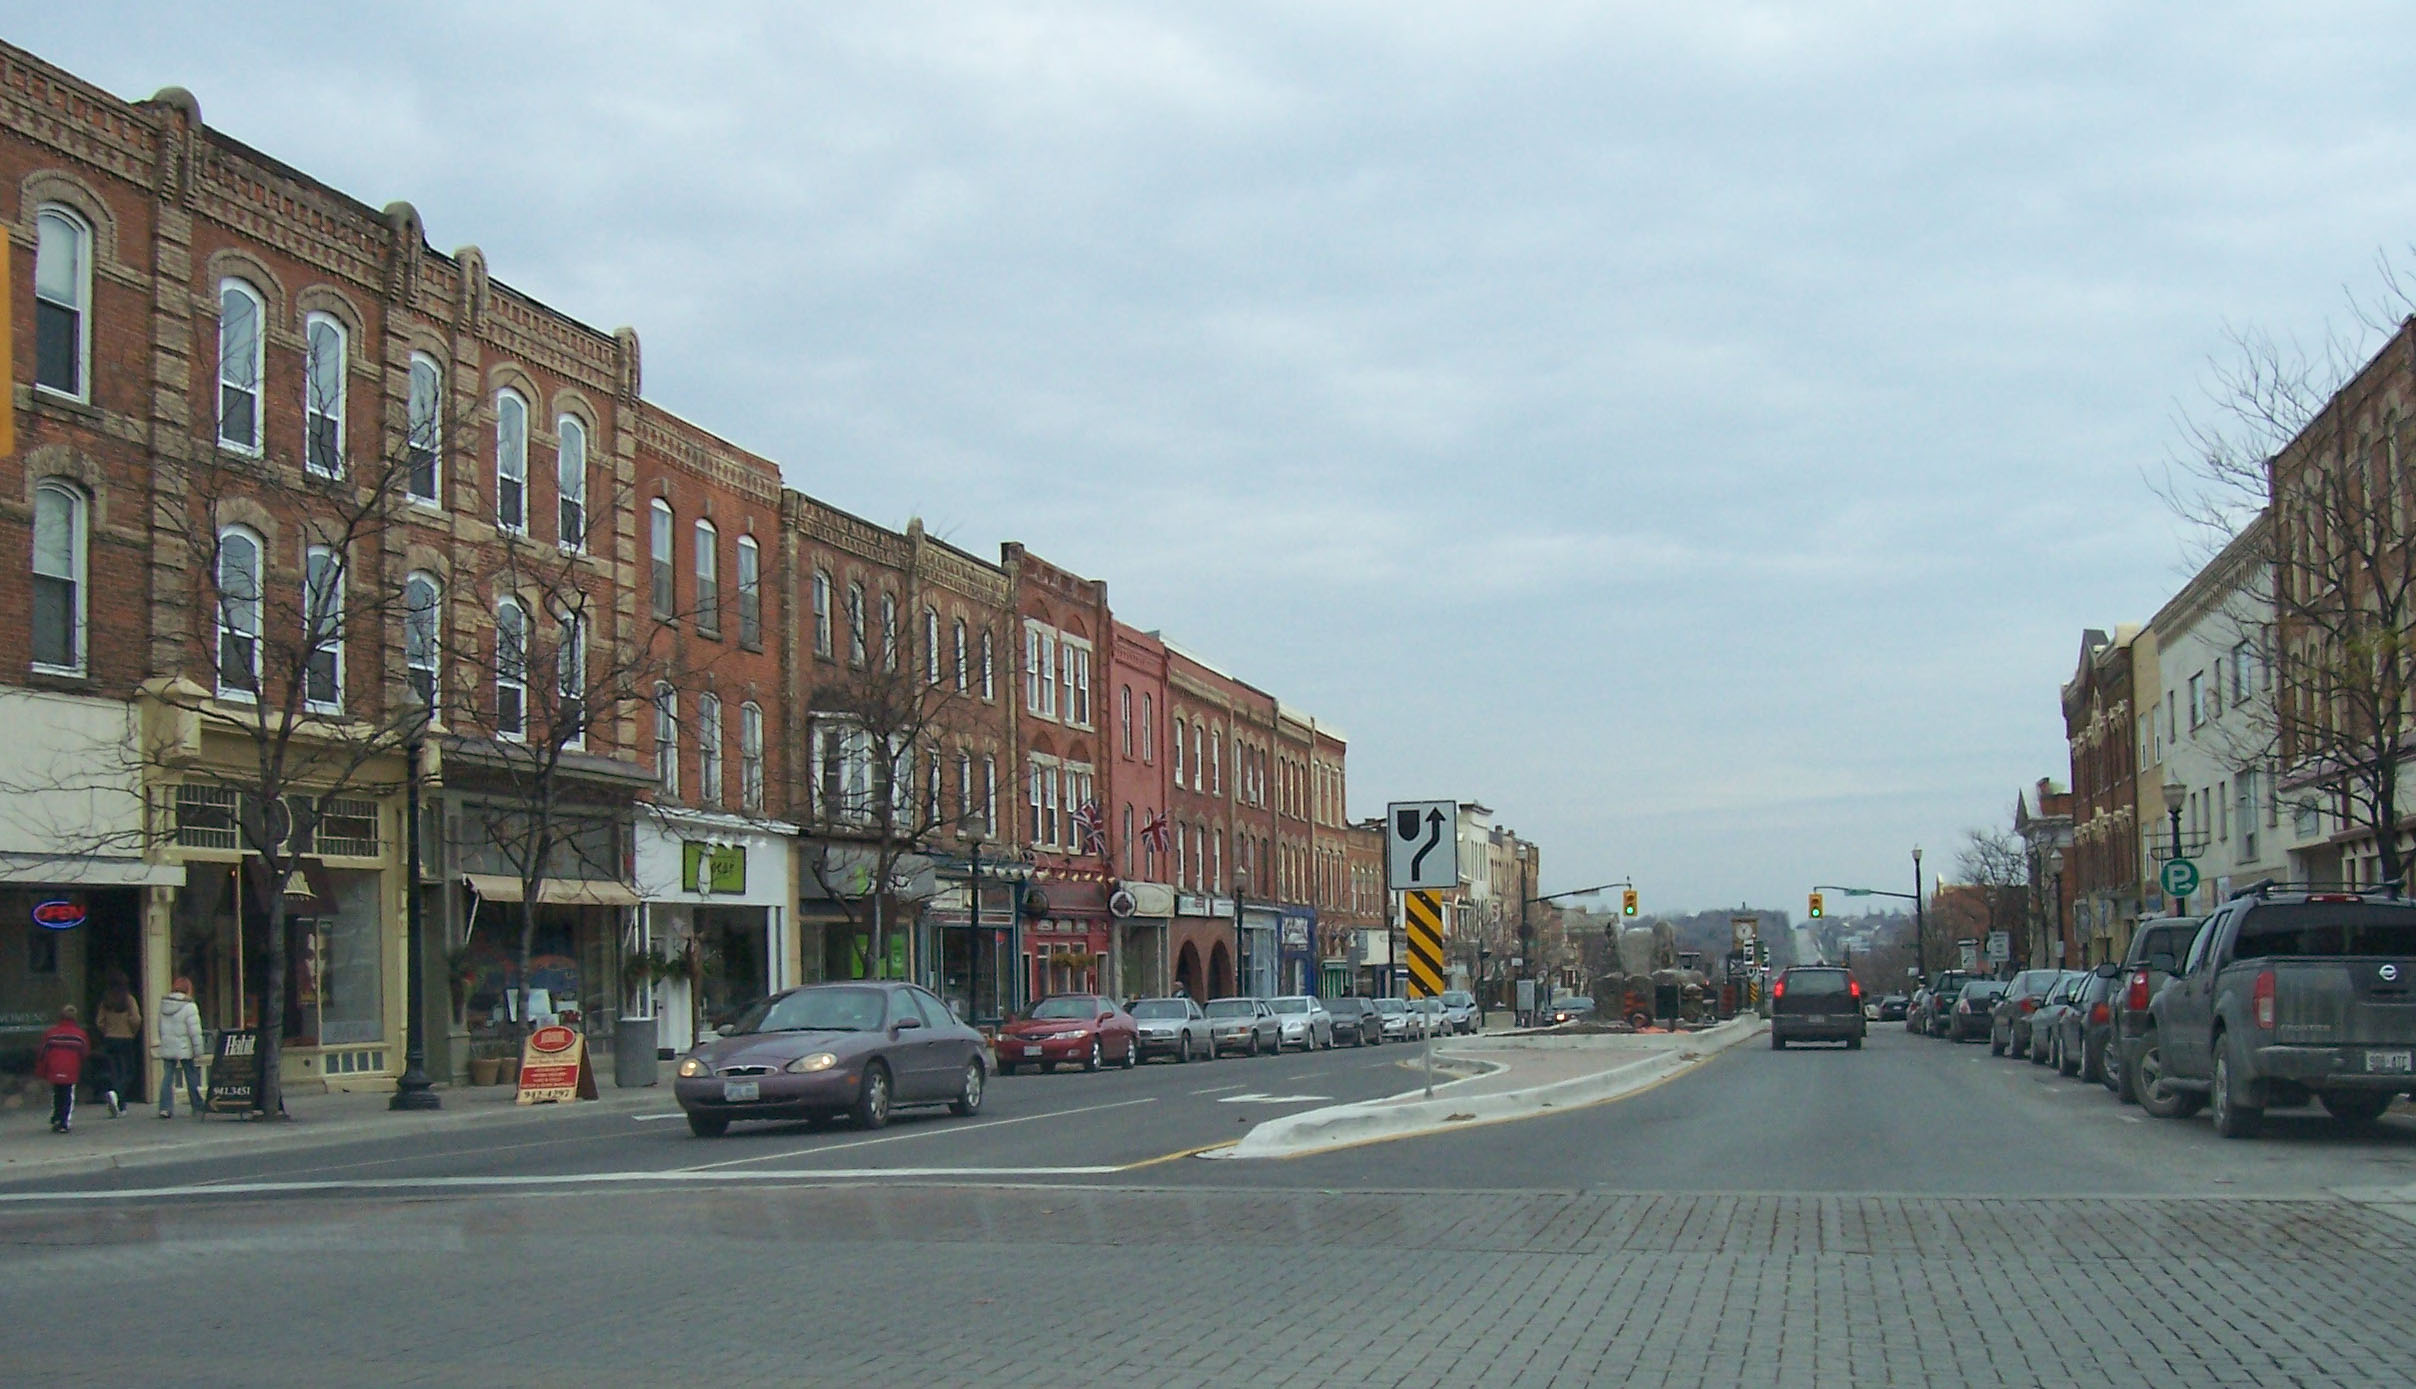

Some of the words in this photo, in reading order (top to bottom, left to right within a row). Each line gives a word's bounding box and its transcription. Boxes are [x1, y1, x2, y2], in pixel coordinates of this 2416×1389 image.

[2167, 864, 2192, 892] P
[38, 904, 87, 920] OPEN
[225, 1034, 256, 1056] Habit
